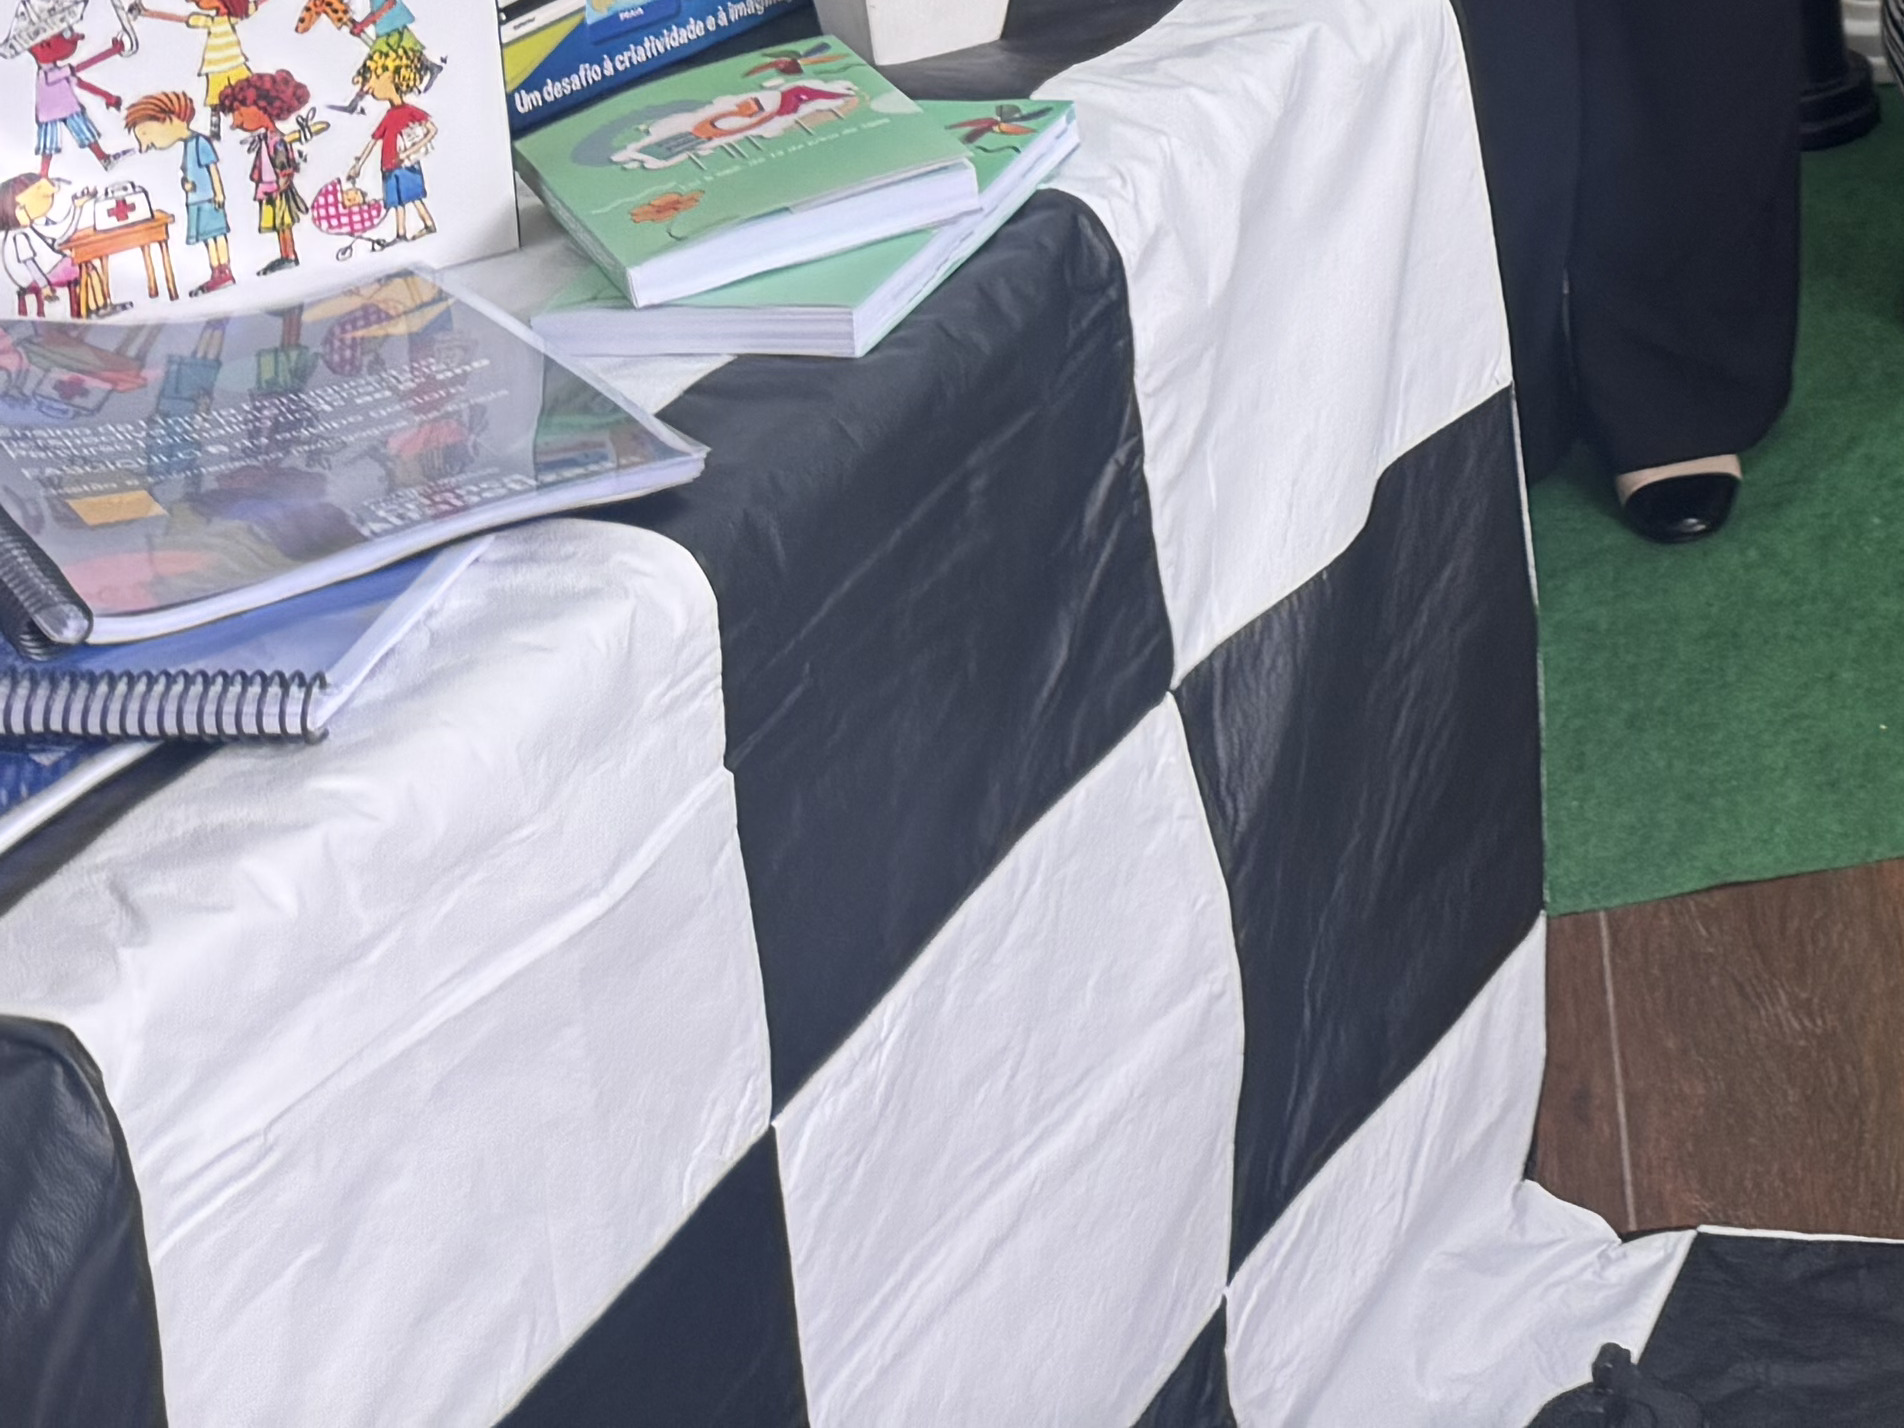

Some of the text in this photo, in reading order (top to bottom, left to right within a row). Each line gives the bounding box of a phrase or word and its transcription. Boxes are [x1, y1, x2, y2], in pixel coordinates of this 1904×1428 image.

[514, 88, 543, 114] Um
[542, 60, 603, 101] desafio
[602, 53, 615, 76] à
[614, 15, 706, 72] criatividade
[705, 12, 717, 30] e
[716, 6, 729, 27] à
